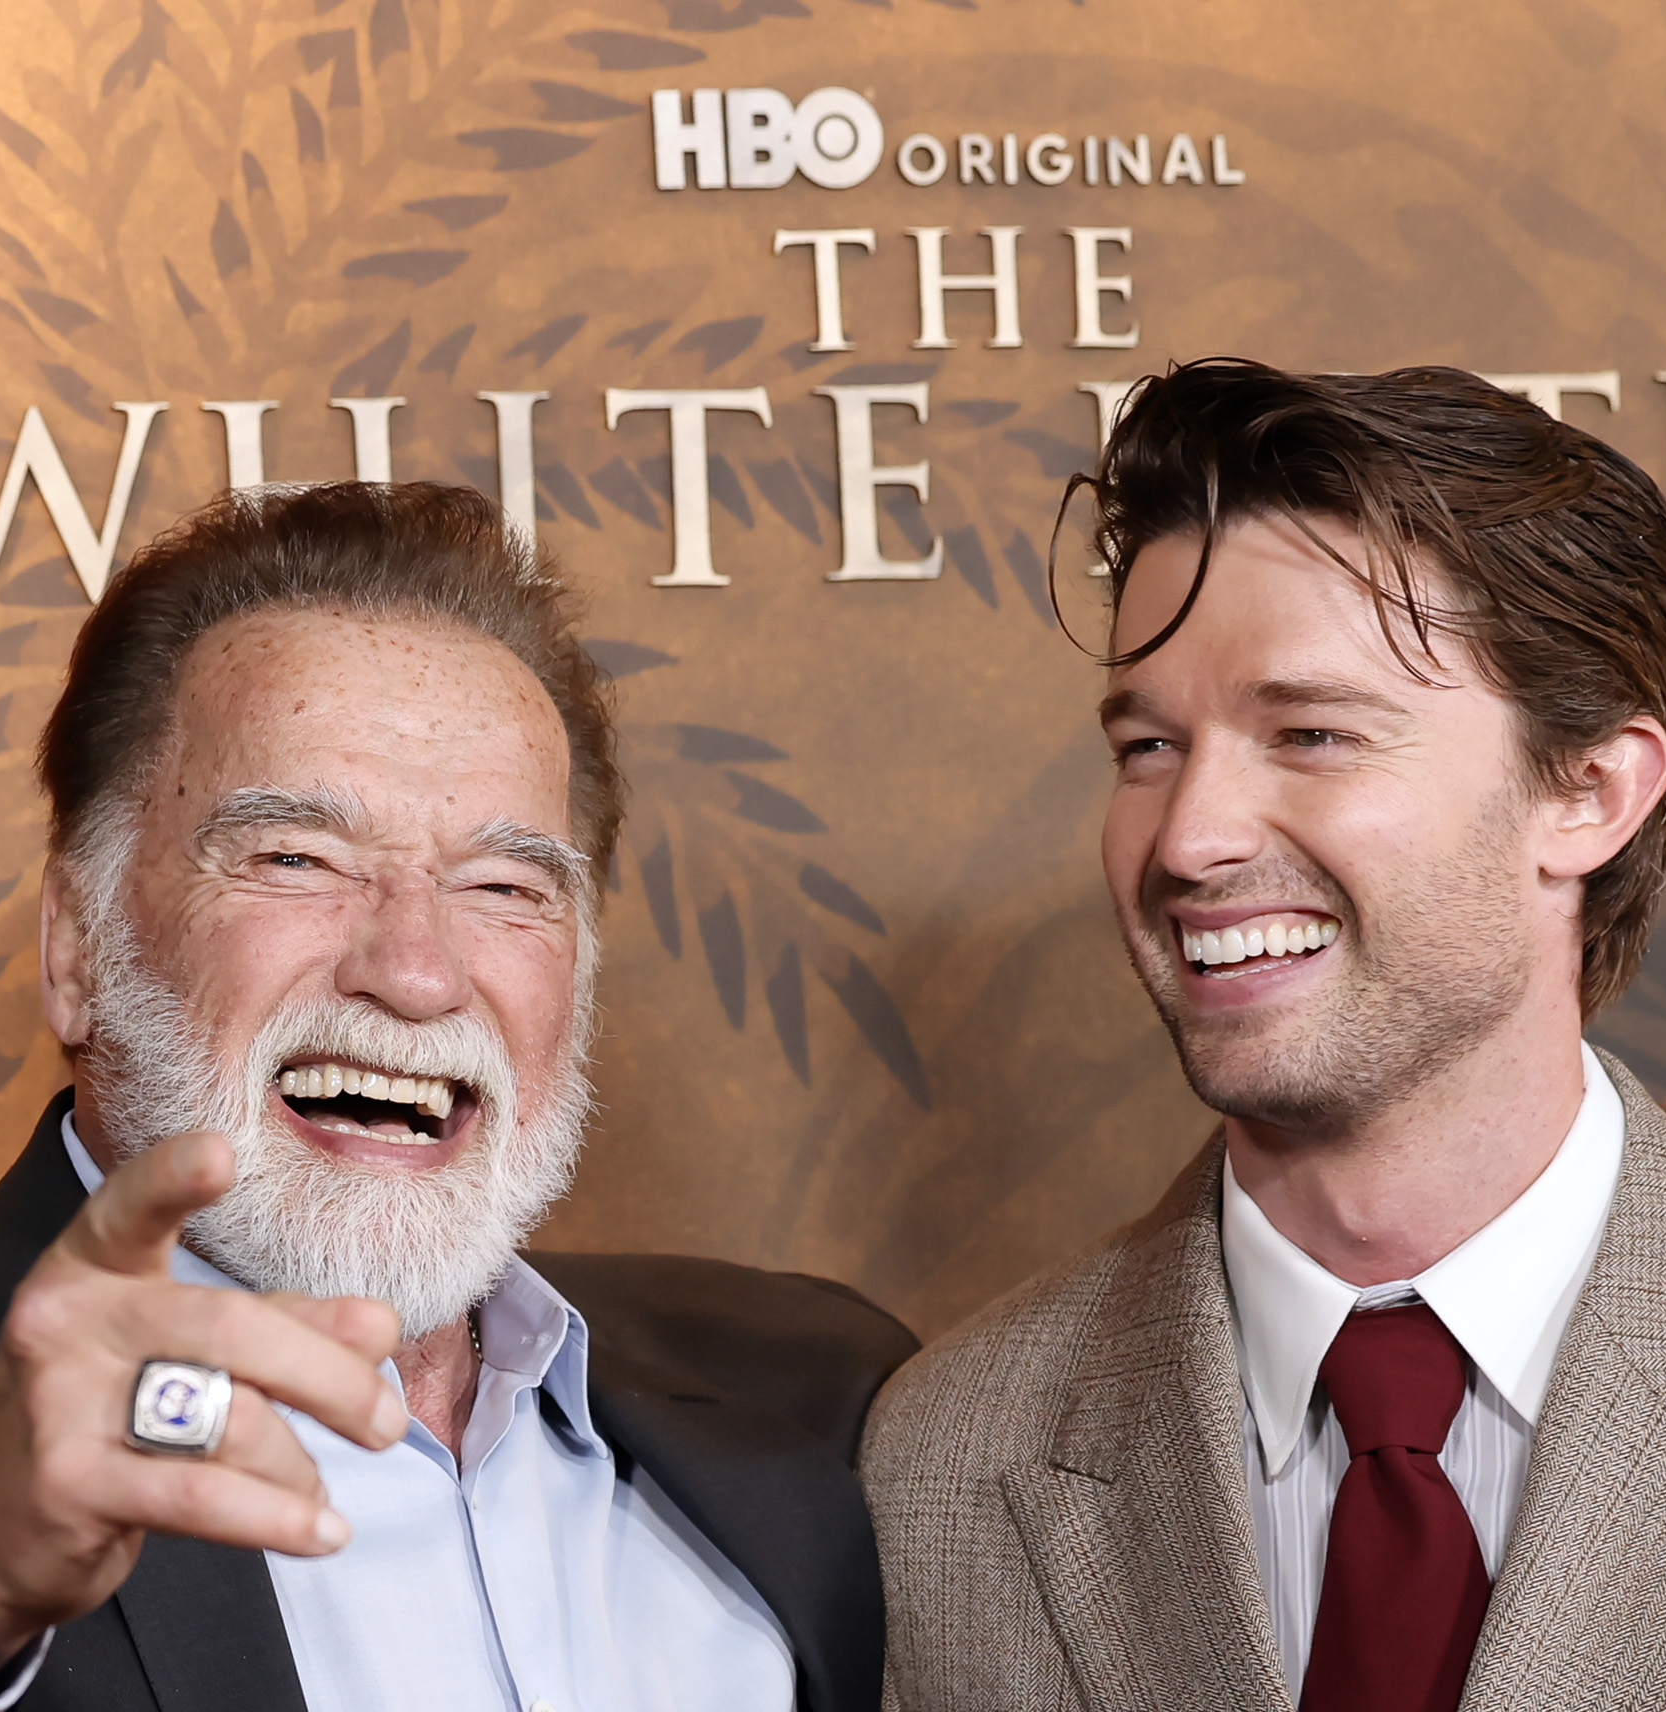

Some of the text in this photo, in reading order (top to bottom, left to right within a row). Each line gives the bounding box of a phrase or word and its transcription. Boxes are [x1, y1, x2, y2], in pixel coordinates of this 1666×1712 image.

[651, 86, 1246, 190] HBO ORIGINAL
[773, 226, 1139, 352] THE
